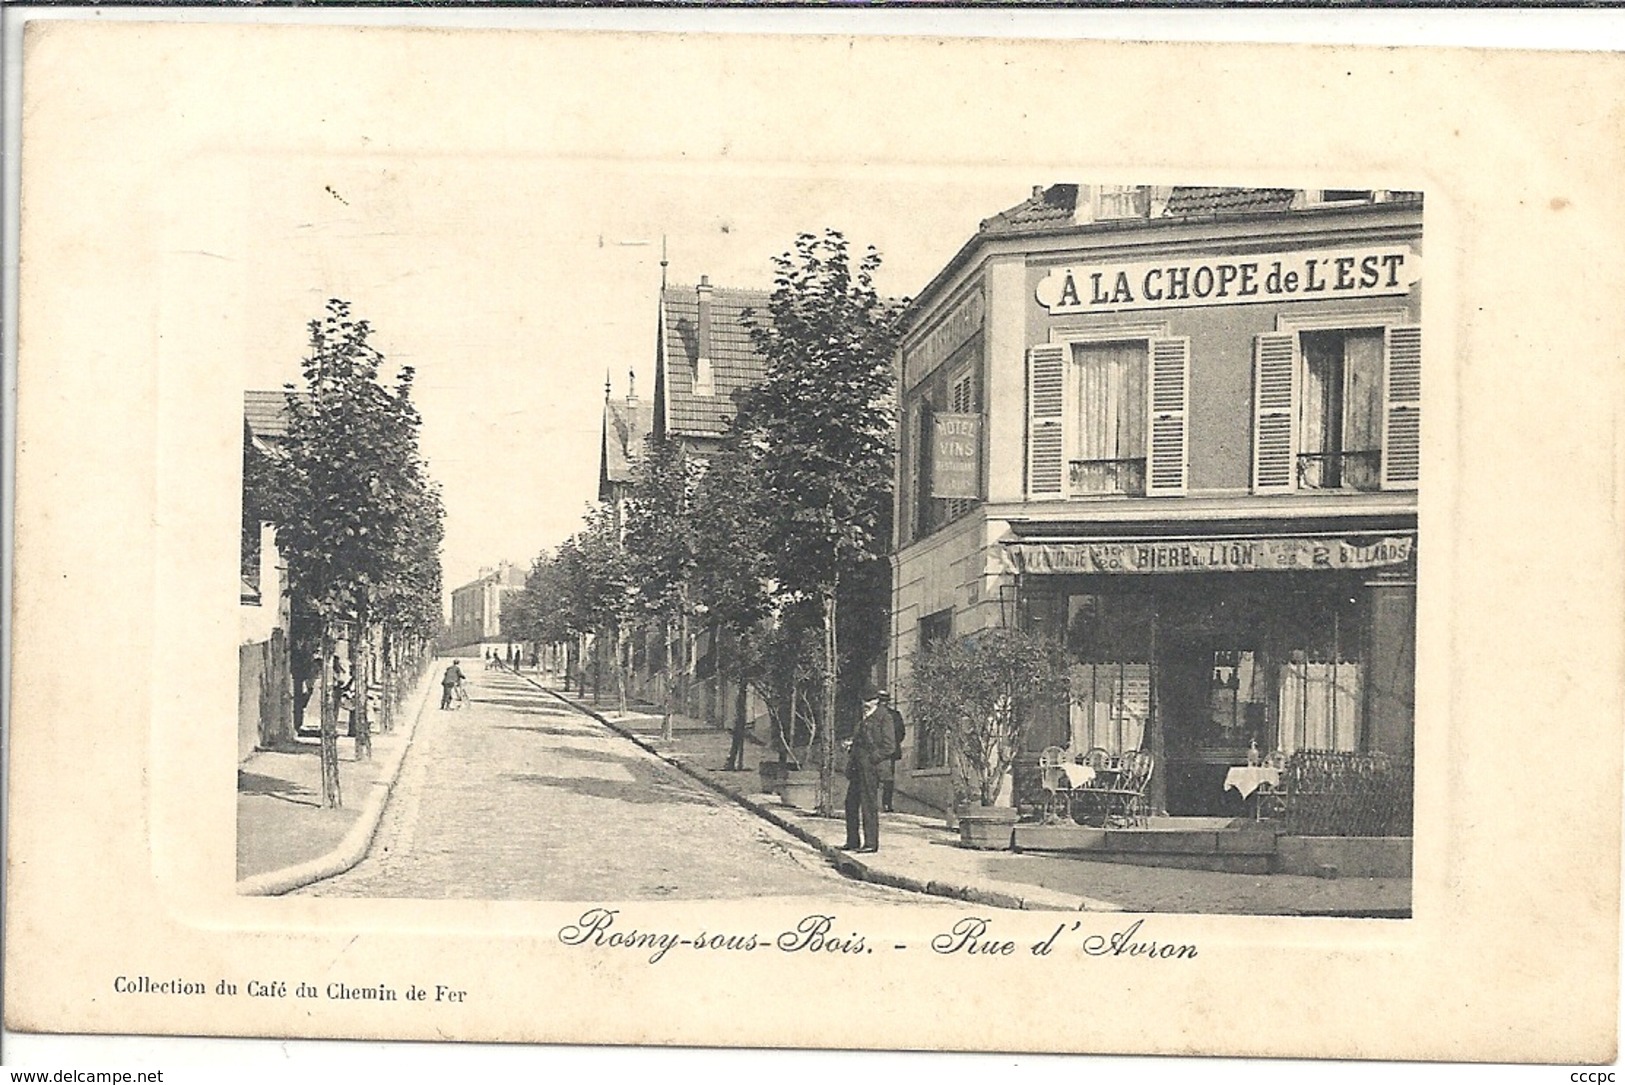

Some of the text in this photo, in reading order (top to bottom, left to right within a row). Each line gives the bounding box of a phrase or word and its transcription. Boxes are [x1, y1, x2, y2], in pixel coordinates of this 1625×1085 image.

[1090, 271, 1134, 305] LA
[1142, 262, 1259, 301] CHOPE
[1265, 261, 1299, 294] de
[1304, 253, 1405, 293] L'EST
[940, 441, 974, 457] VINS
[1208, 544, 1253, 566] LION
[1276, 554, 1298, 566] 25
[1339, 544, 1407, 563] BILLARDS
[931, 916, 1015, 956] Rue
[114, 976, 467, 1003] Collection du Café du Chemin de Fer
